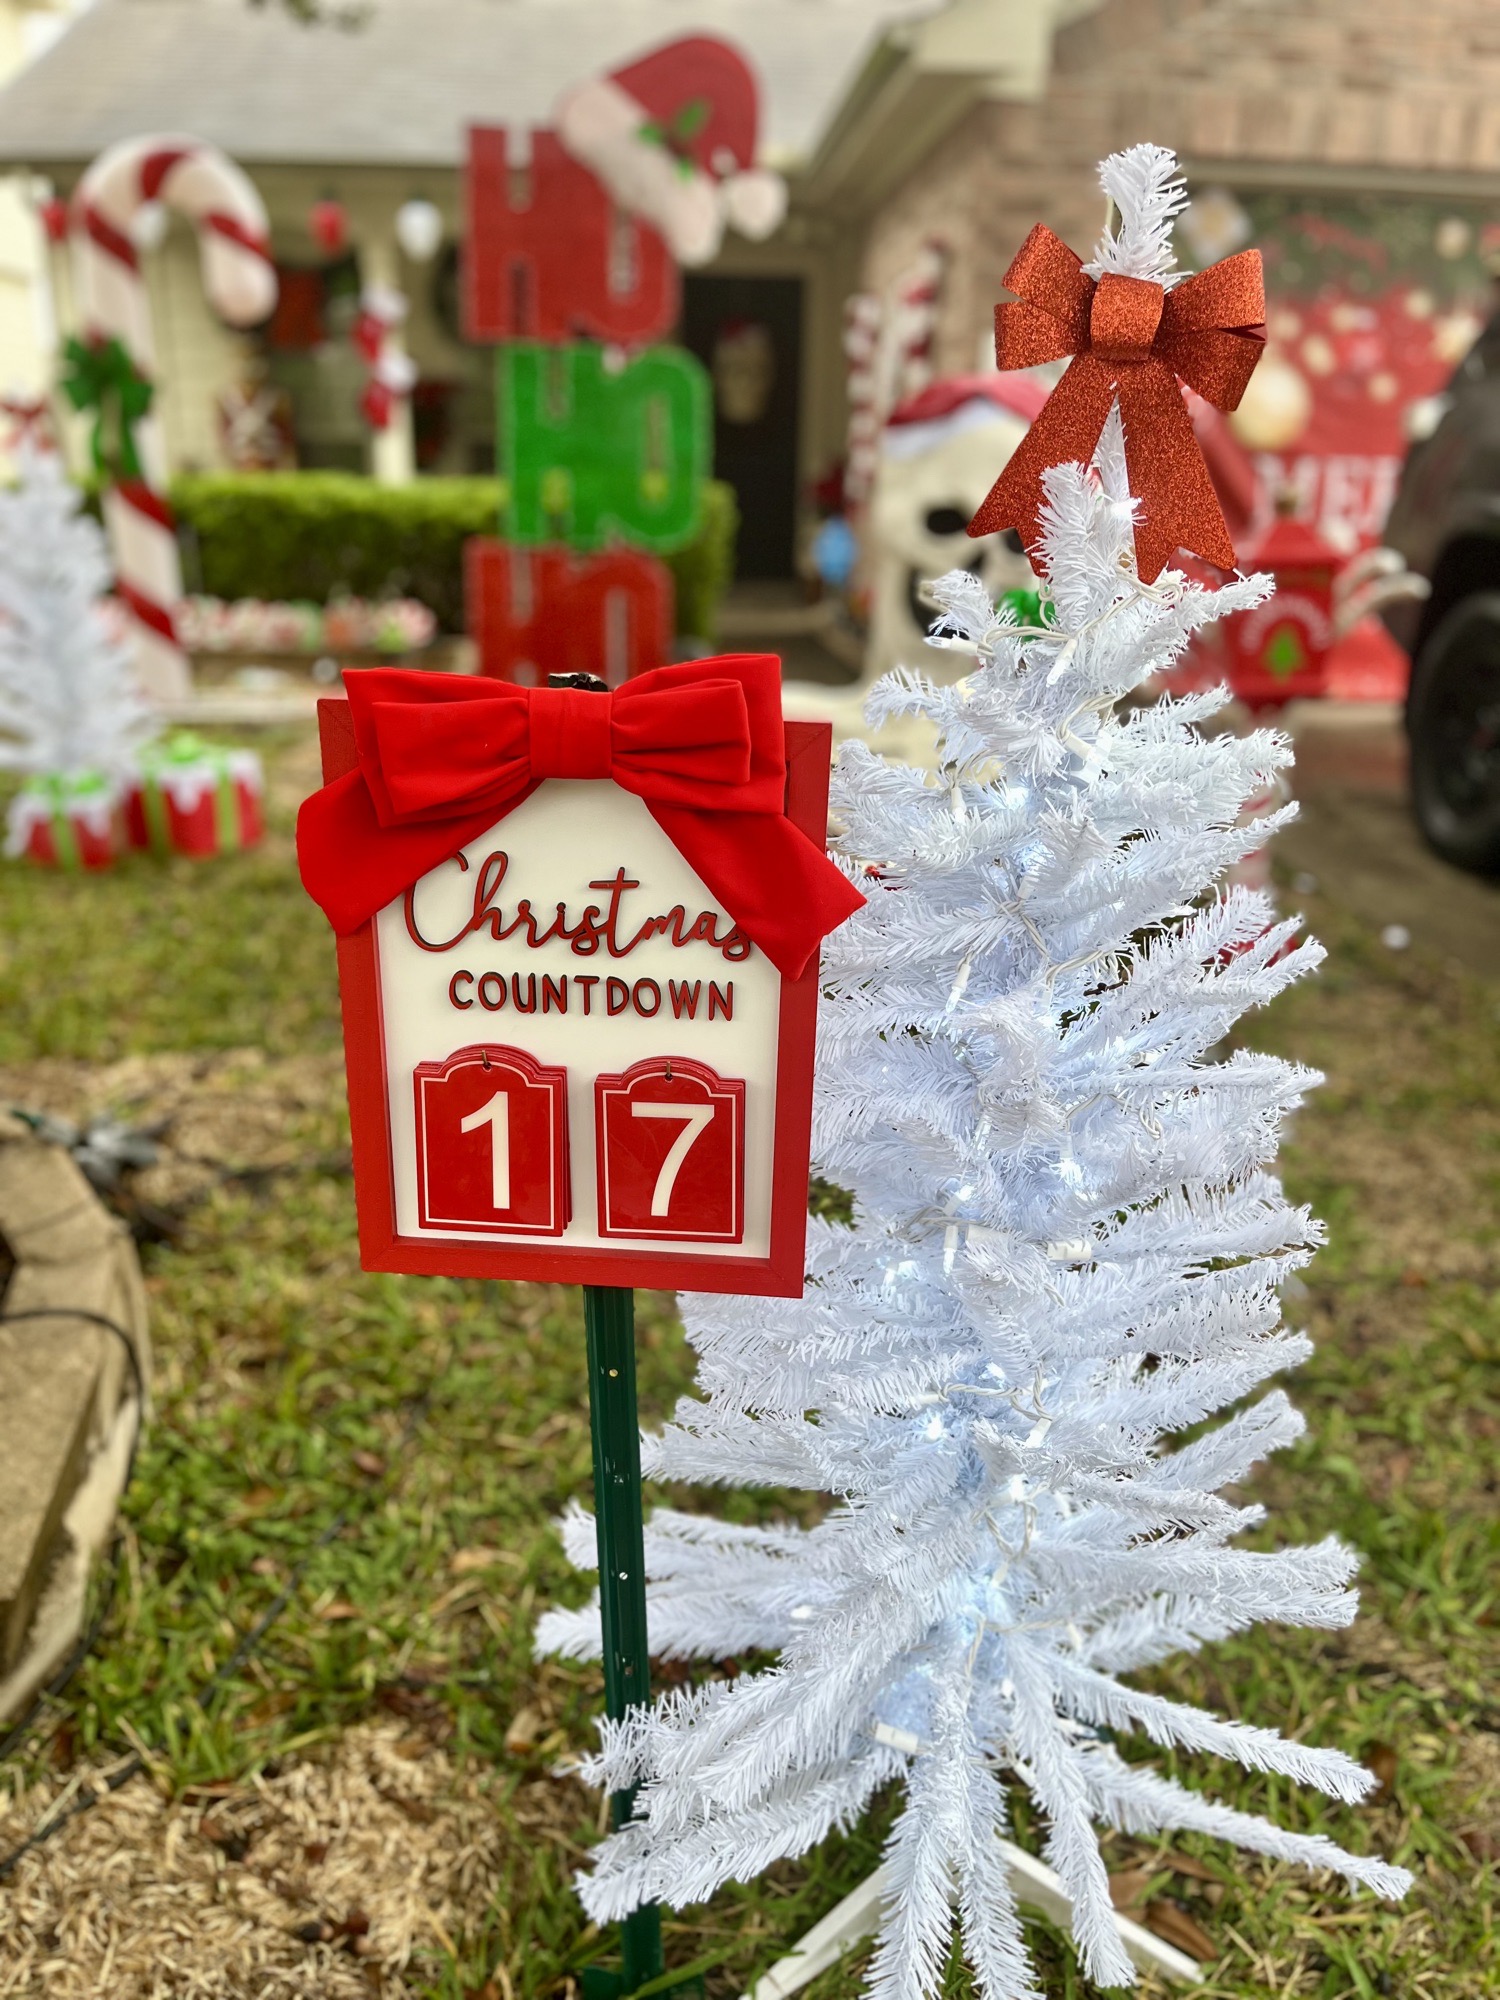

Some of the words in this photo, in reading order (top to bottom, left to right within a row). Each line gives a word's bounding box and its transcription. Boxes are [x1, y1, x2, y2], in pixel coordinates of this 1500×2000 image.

[465, 122, 681, 342] HO
[501, 345, 711, 551] HO
[404, 850, 751, 962] Christmas
[448, 969, 735, 1022] COUNTDOWN
[460, 1090, 511, 1210] 1
[631, 1101, 715, 1218] 7
